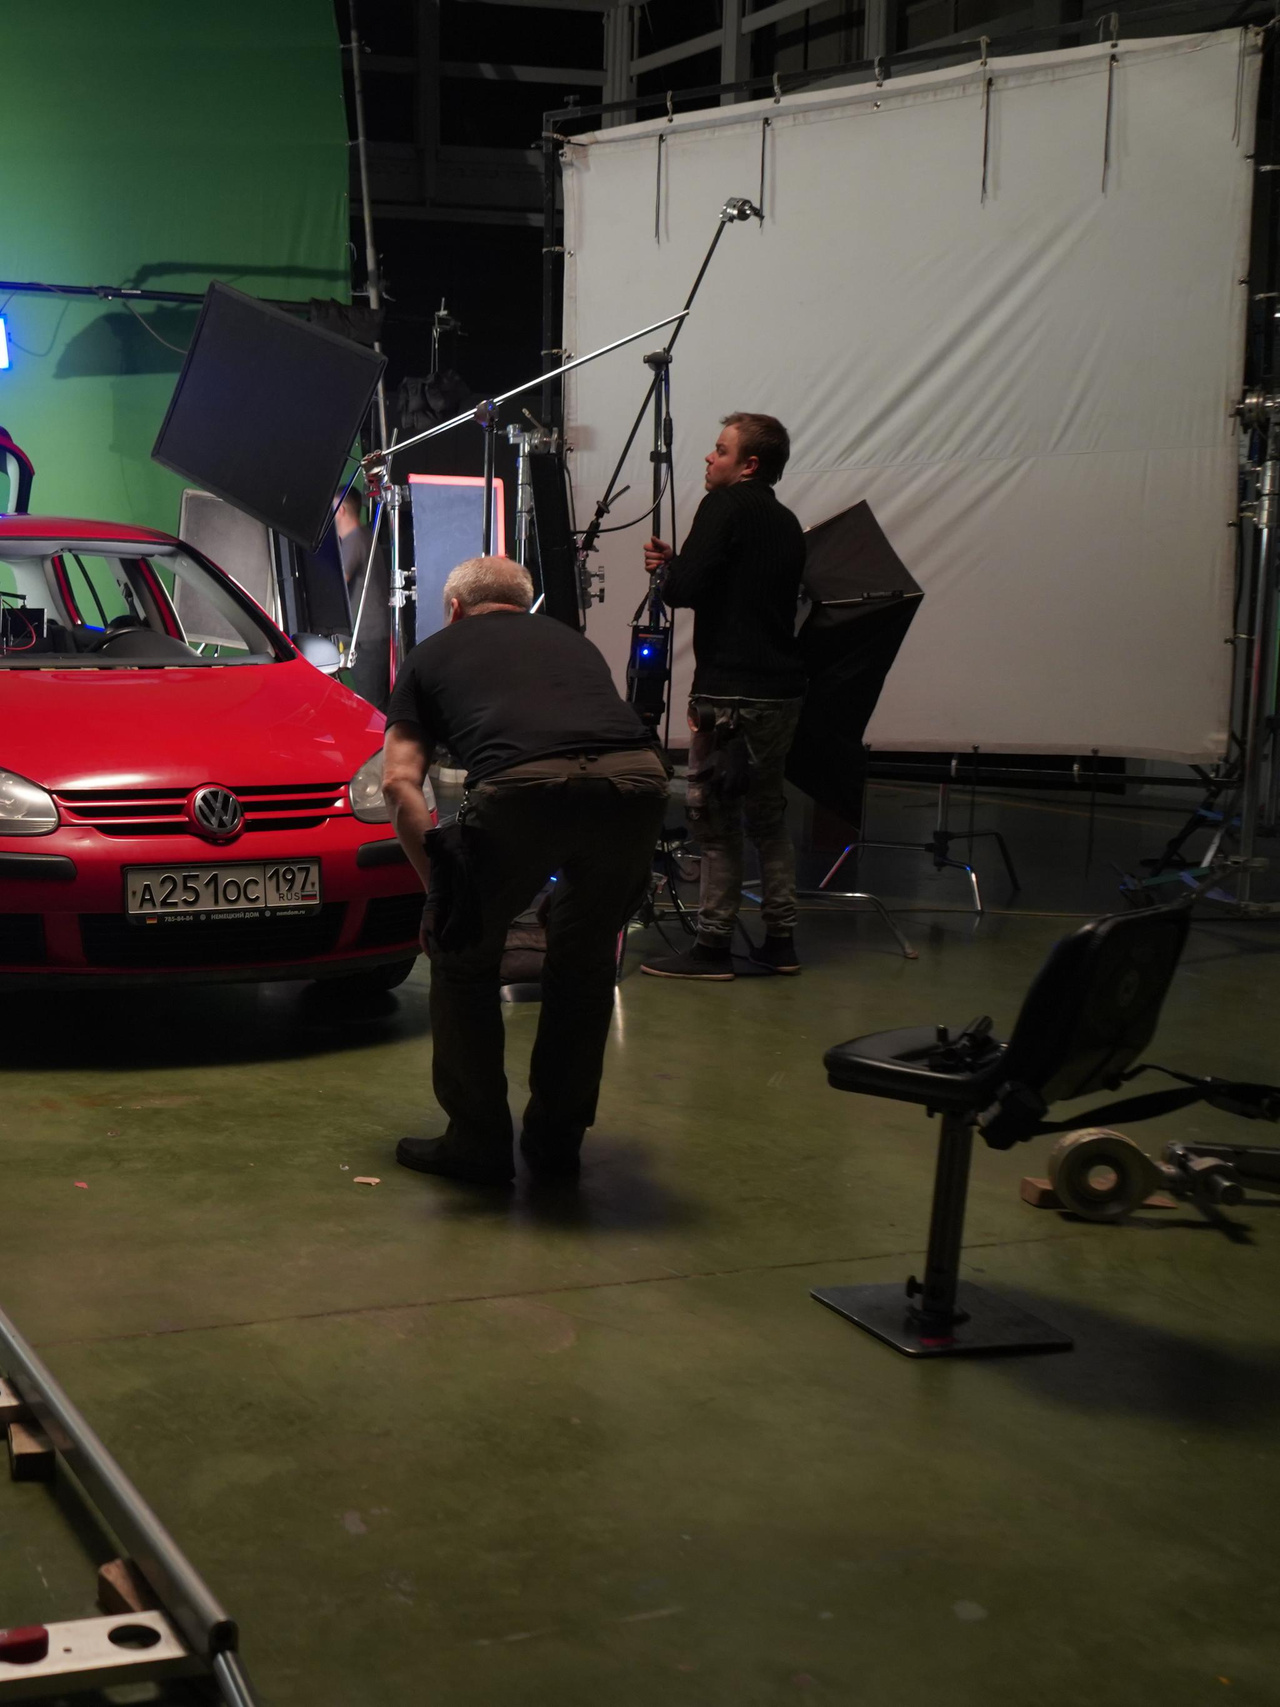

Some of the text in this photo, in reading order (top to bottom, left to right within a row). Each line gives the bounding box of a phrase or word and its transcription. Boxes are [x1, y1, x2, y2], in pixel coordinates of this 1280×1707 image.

[267, 865, 311, 894] 197
[278, 892, 301, 902] RUS
[210, 912, 244, 920] НЕМЕЦКИЙ
[244, 911, 260, 919] ДОМ
